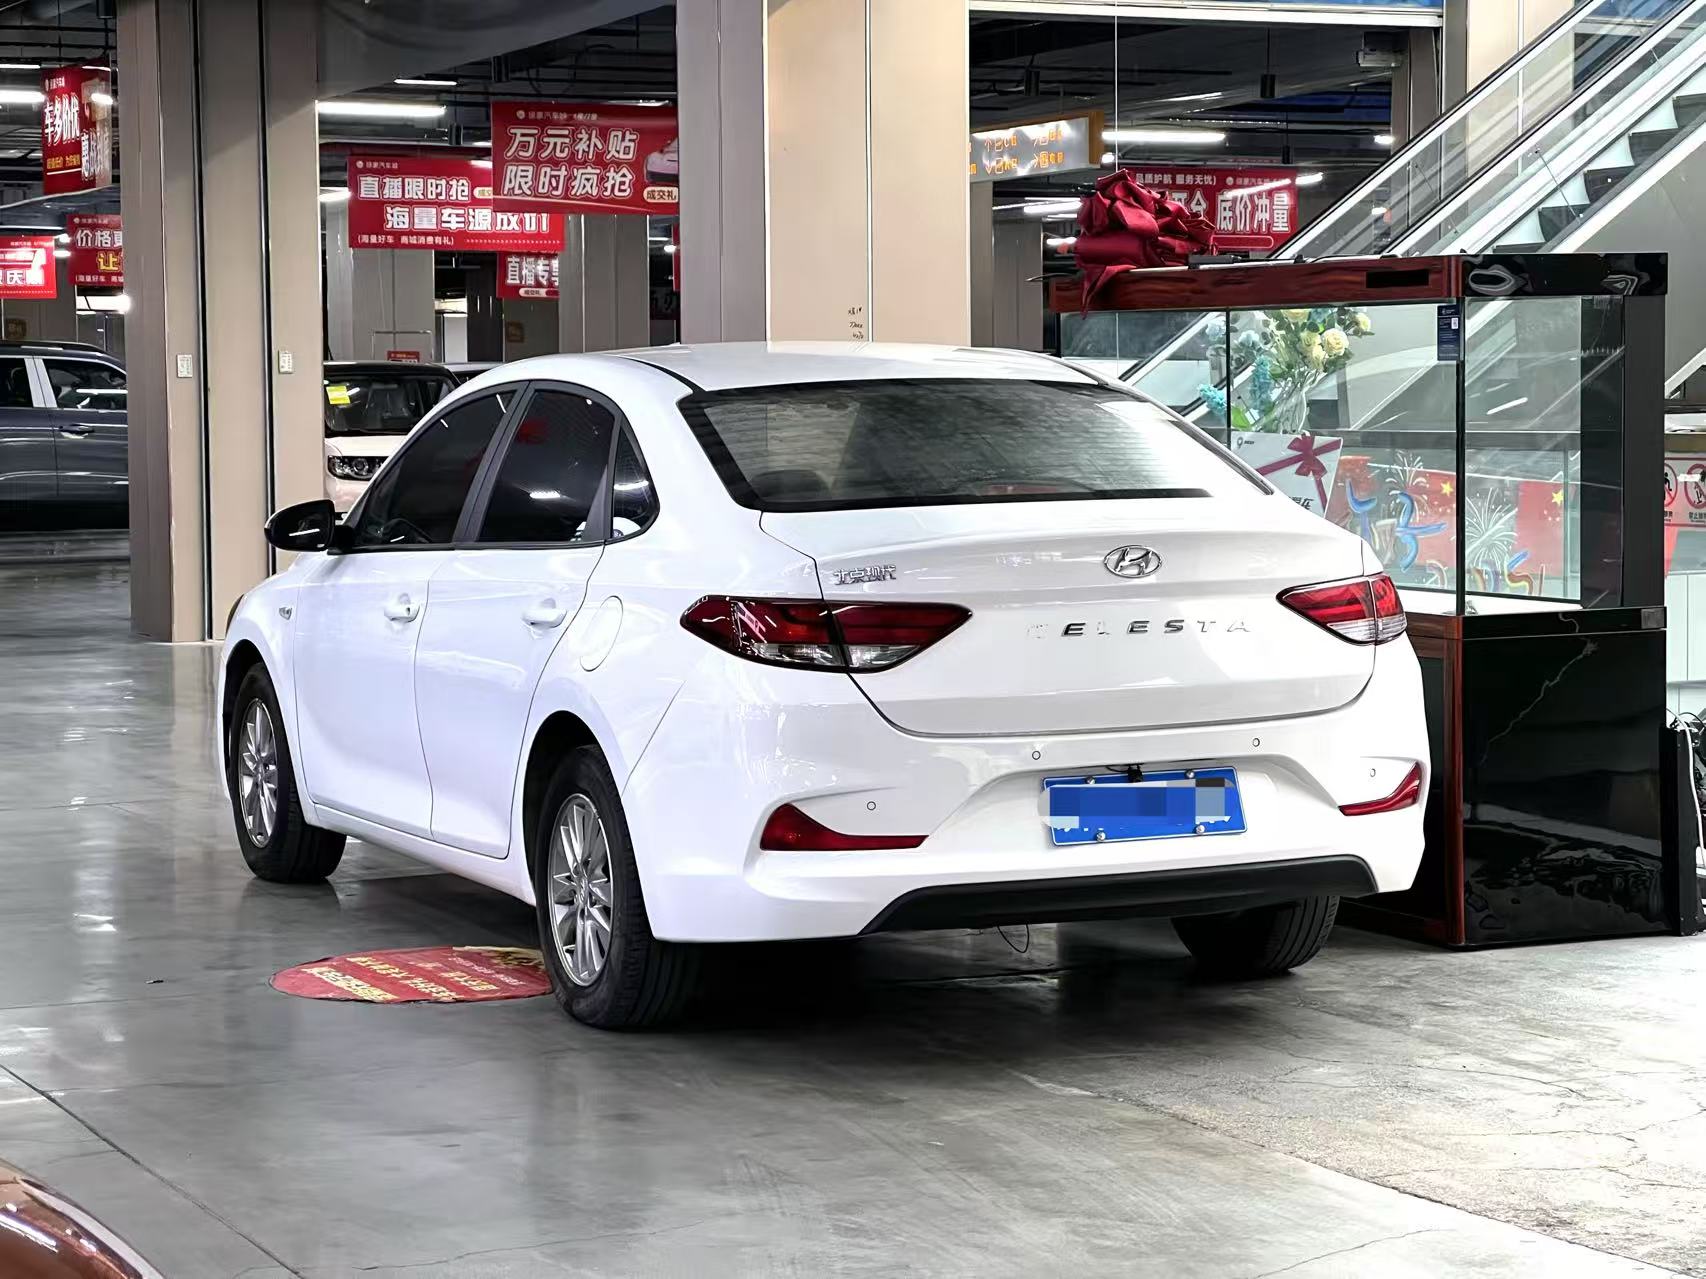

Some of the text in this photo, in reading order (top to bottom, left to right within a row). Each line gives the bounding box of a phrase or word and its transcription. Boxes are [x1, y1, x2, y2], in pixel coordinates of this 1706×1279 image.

[505, 127, 639, 161] 万元补贴
[358, 174, 471, 202] 直播限时抢
[503, 163, 634, 198] 限时疯抢
[1216, 190, 1289, 233] 底价冲量
[1026, 618, 1251, 639] ELESTA
